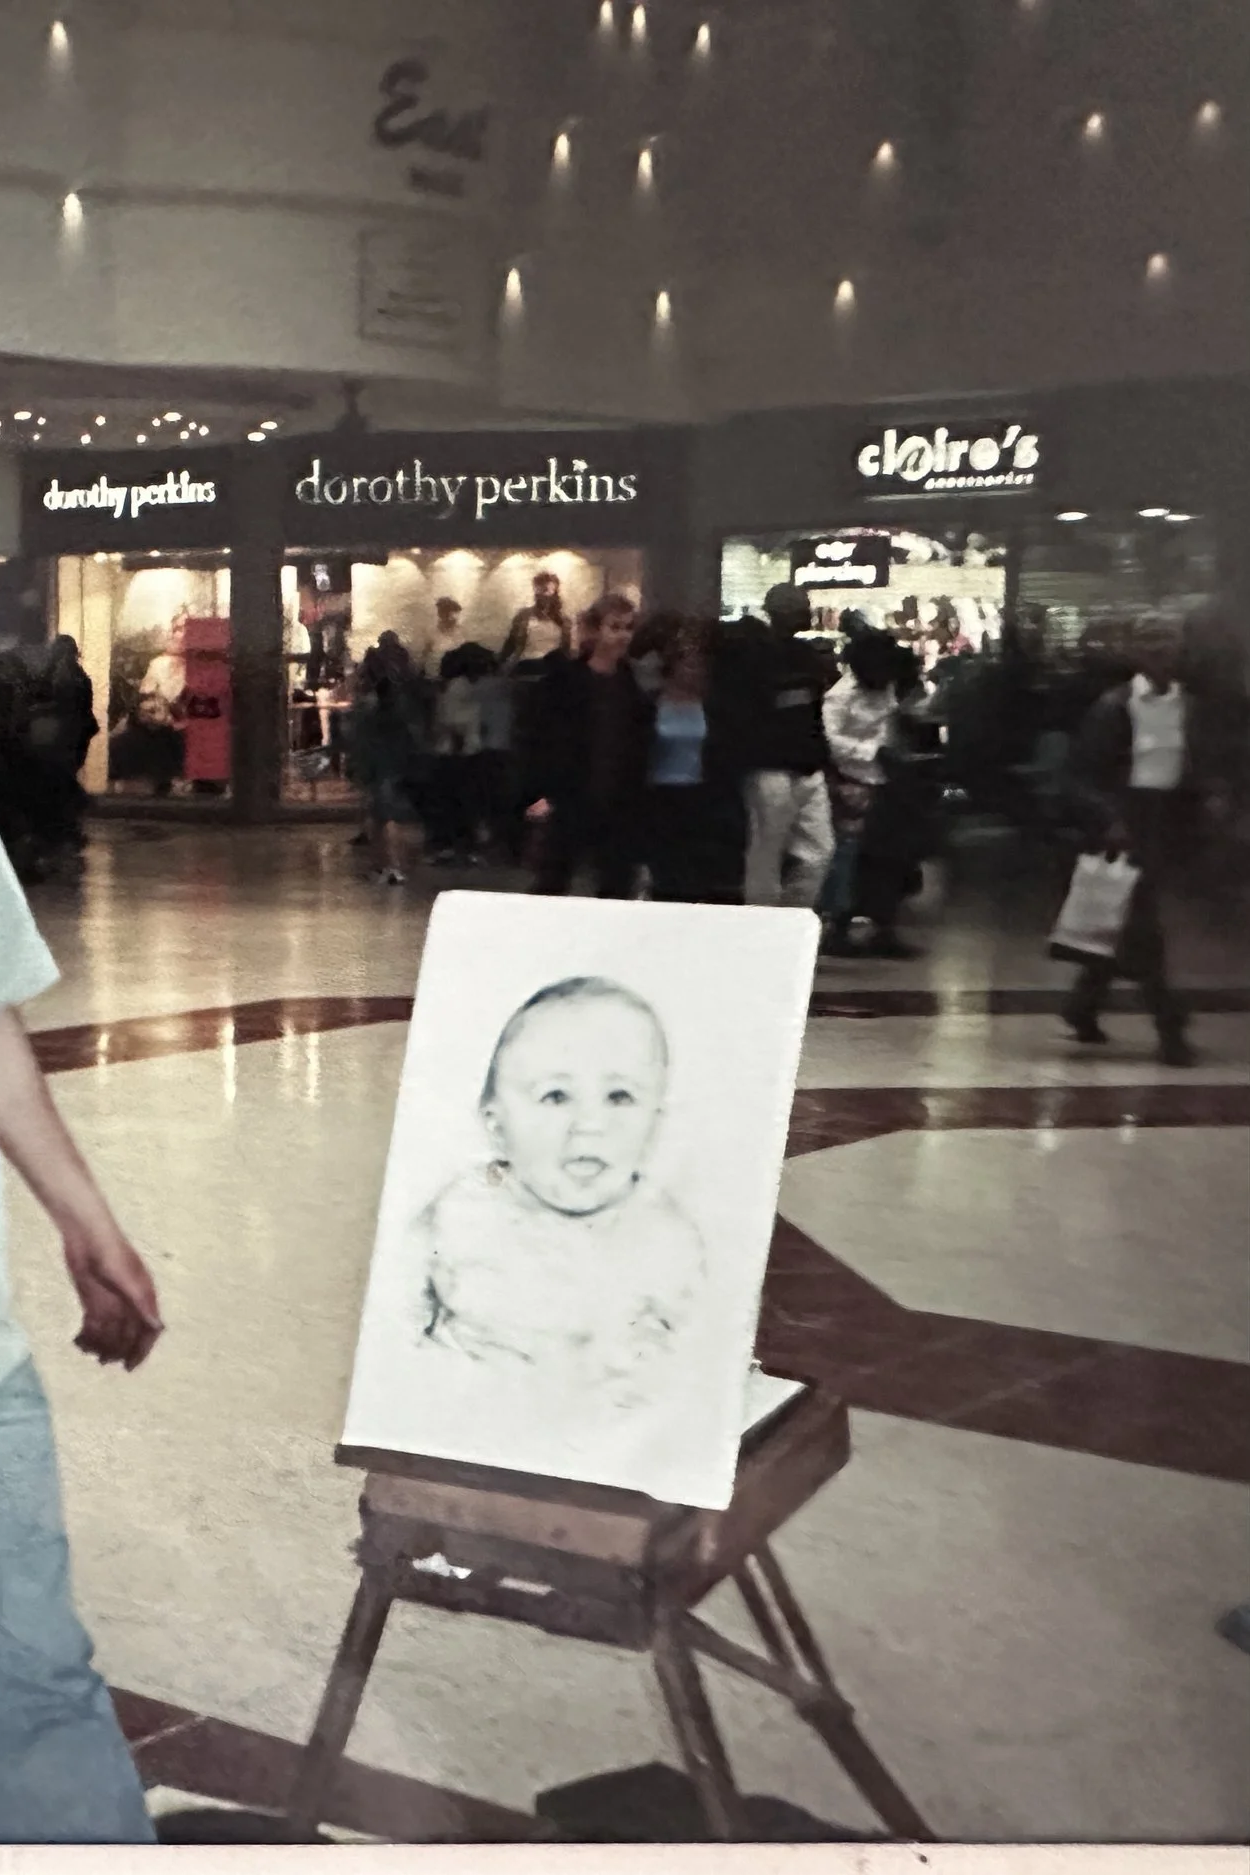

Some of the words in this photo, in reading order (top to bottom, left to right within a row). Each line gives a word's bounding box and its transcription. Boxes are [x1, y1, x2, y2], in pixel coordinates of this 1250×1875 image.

[42, 476, 128, 519] dorothy
[130, 470, 217, 518] perkins
[295, 458, 468, 520] dorothy
[474, 456, 638, 520] perkins
